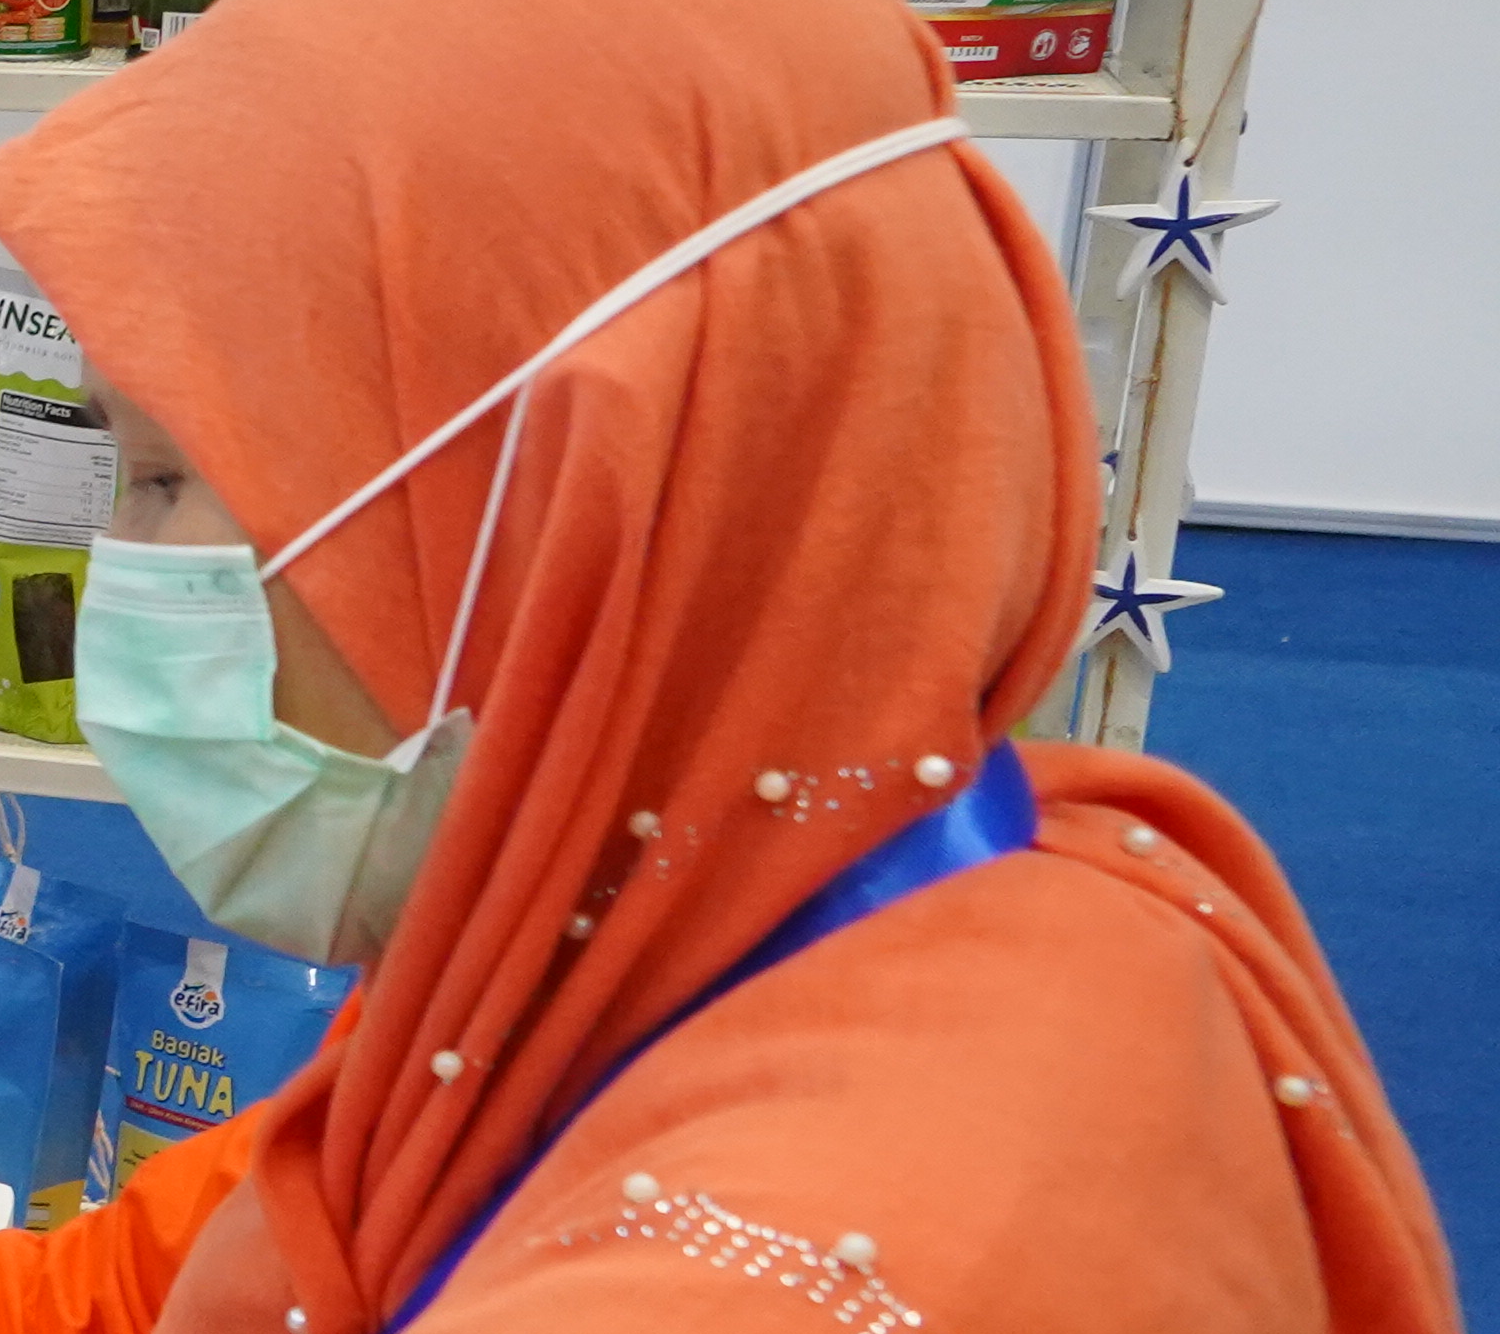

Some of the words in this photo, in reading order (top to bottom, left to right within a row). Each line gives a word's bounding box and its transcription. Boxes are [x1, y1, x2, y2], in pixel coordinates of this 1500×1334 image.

[2, 393, 44, 414] Nutrition
[44, 402, 72, 419] Facts
[174, 991, 221, 1017] efira
[150, 1029, 226, 1070] Bagiak
[134, 1049, 236, 1119] TUNA
